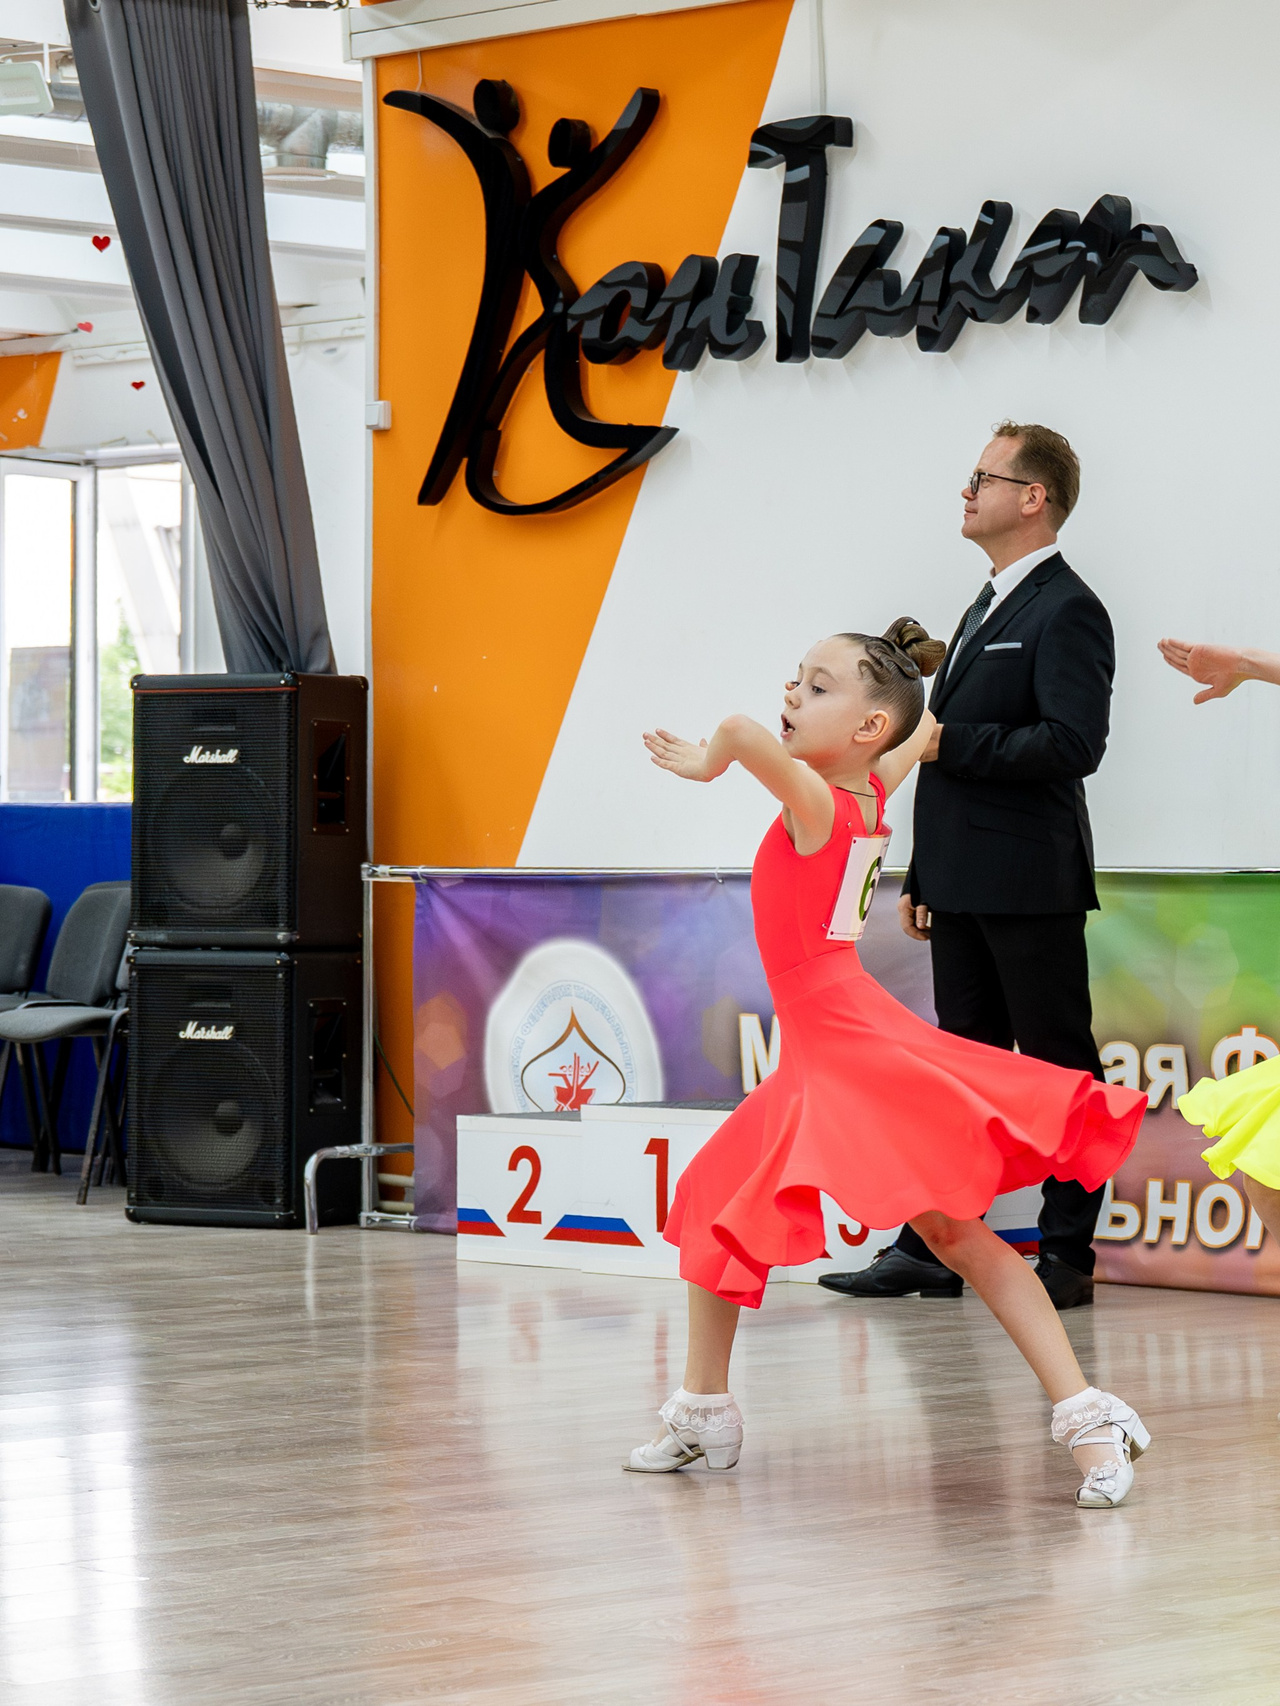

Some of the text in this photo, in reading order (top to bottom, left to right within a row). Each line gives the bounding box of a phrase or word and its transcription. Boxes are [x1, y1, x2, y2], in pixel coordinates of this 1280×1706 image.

[183, 745, 239, 764] Marshall
[859, 856, 882, 922] 6
[179, 1020, 234, 1040] Marshall
[507, 1145, 542, 1225] 2
[643, 1137, 669, 1233] 1
